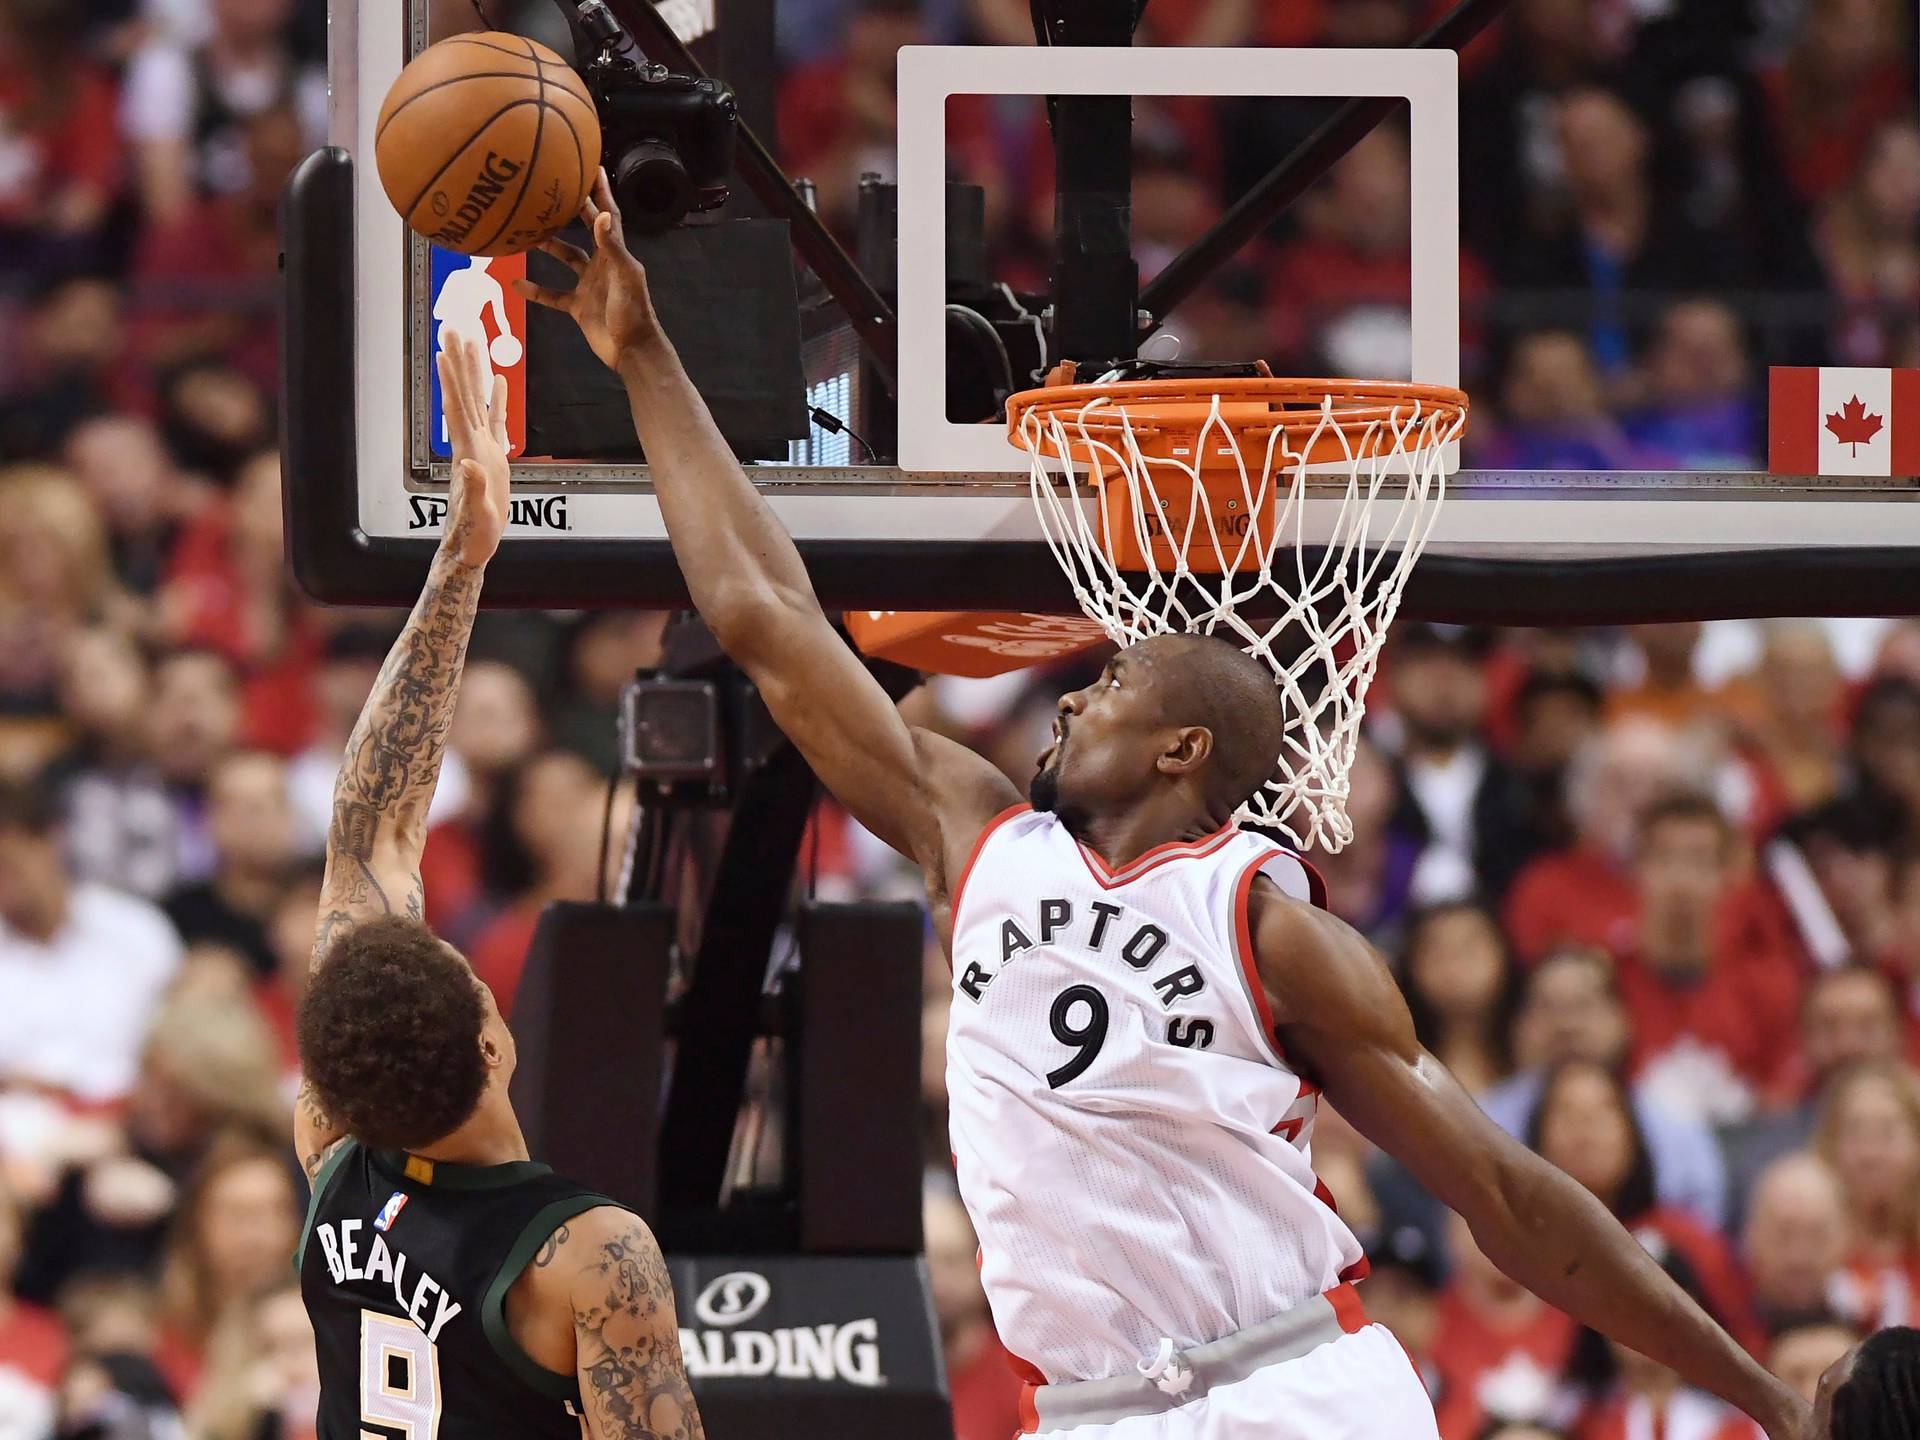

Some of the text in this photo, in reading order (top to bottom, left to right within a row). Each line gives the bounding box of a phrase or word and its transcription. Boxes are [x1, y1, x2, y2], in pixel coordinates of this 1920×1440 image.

[430, 151, 521, 245] PALDING
[409, 495, 567, 530] SPING
[958, 897, 1216, 1052] RAPTORS
[1046, 984, 1109, 1090] 9
[360, 1308, 442, 1440] 9
[678, 1317, 880, 1387] ALDING
